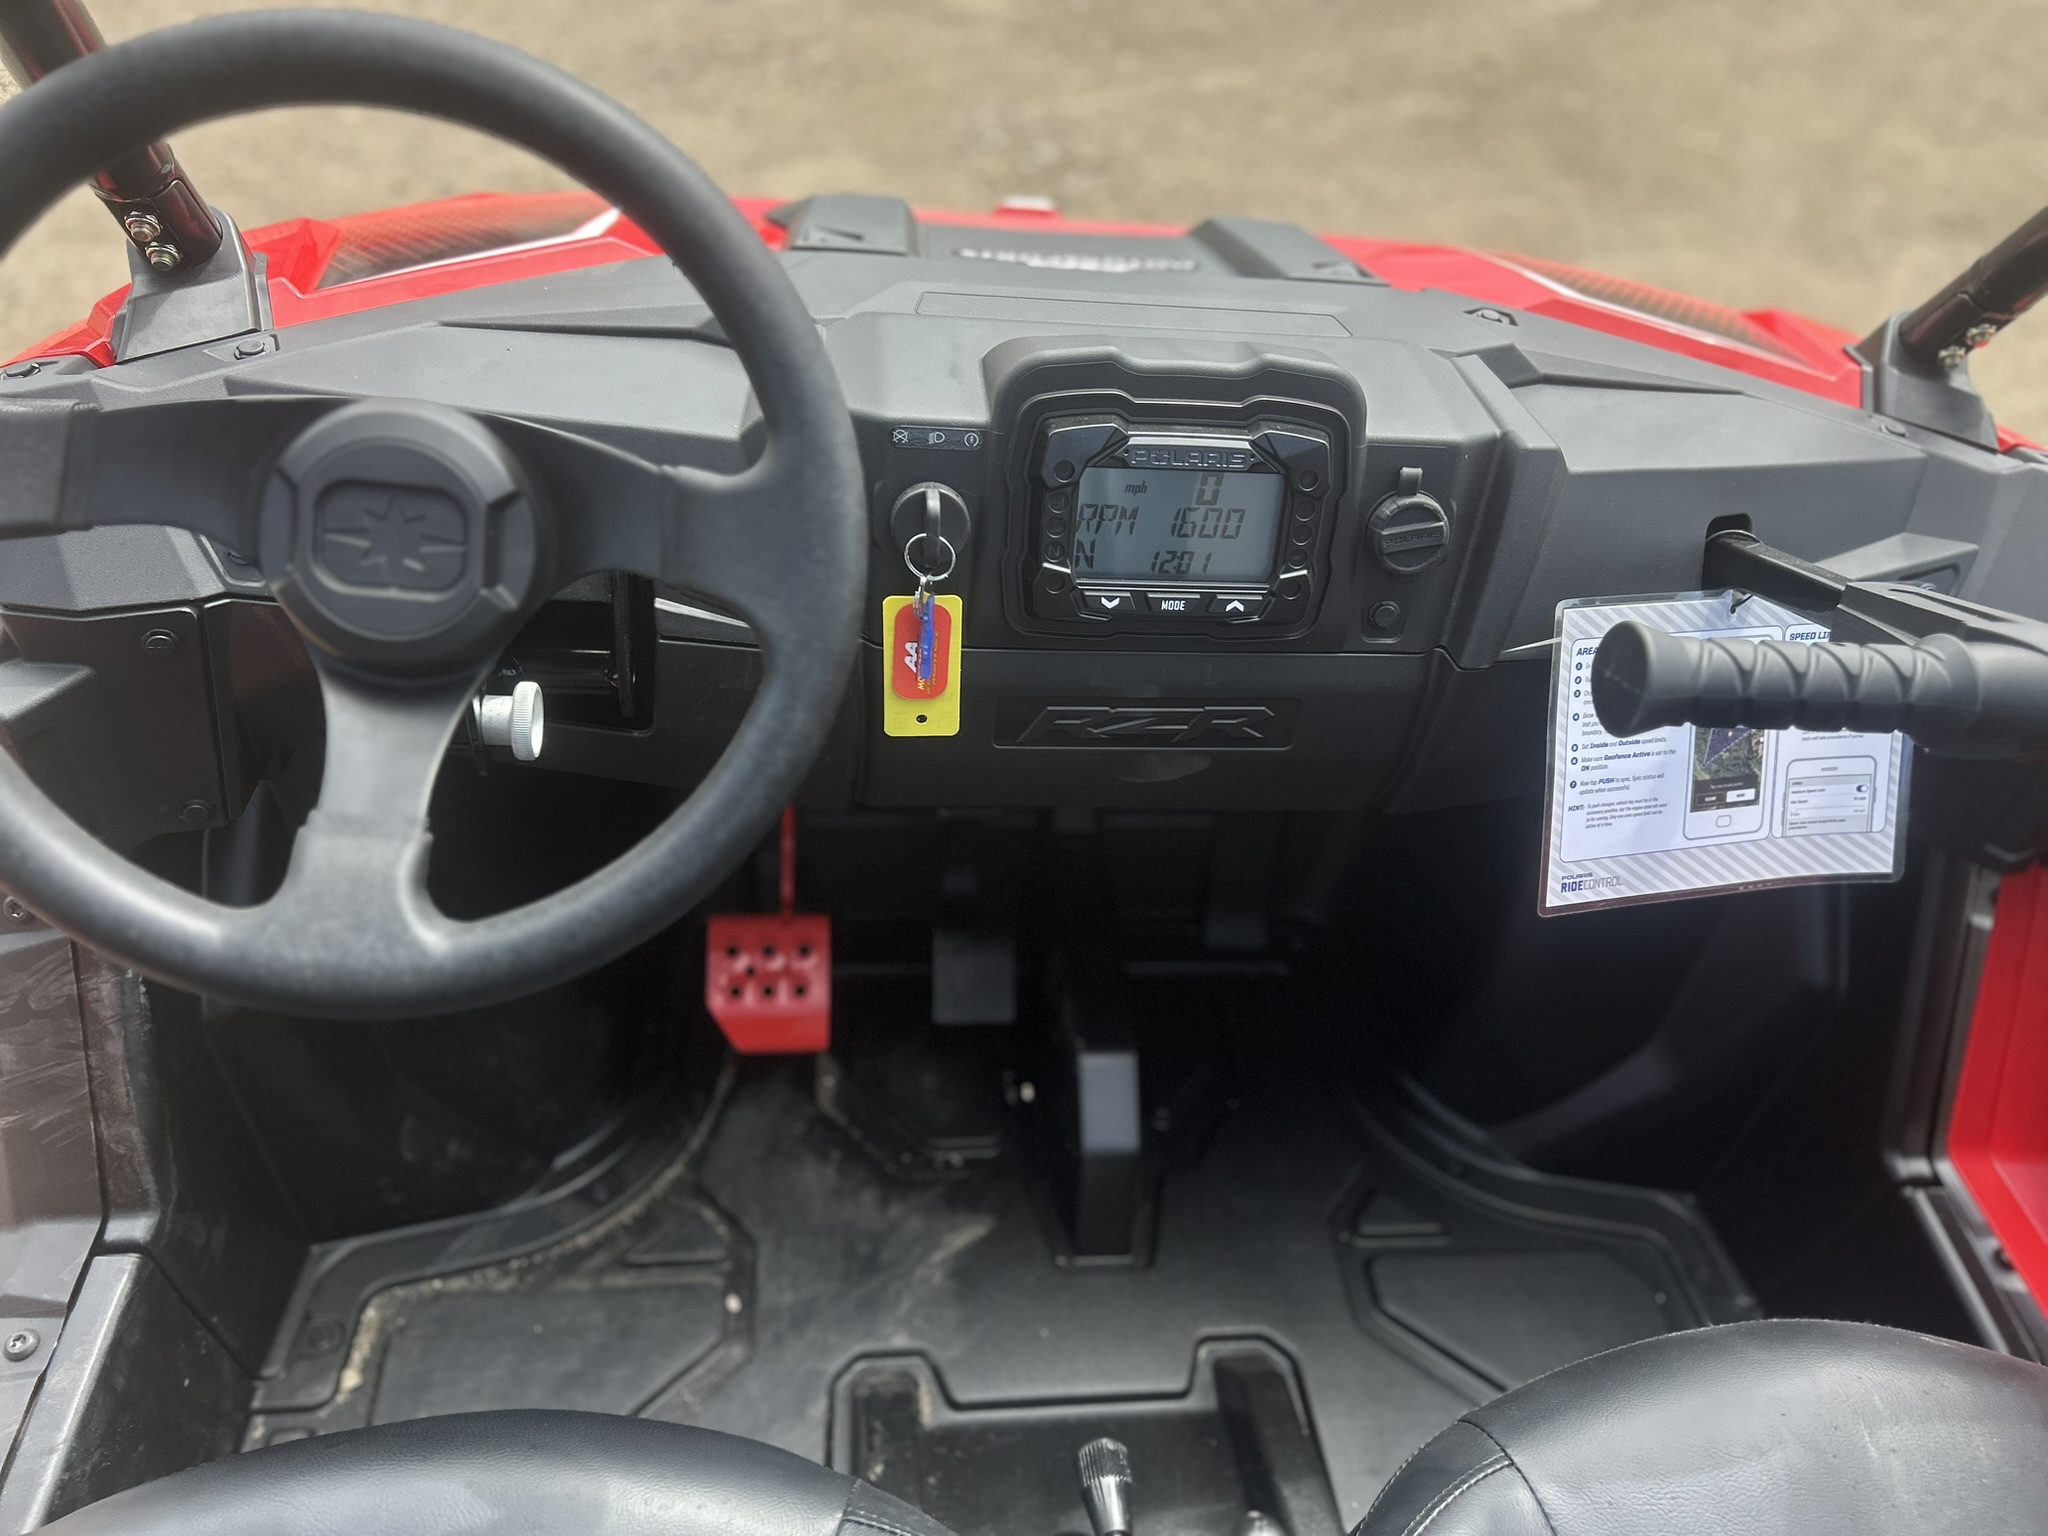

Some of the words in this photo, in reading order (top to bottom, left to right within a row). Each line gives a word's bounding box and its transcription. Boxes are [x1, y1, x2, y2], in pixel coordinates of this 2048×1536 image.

[1131, 449, 1247, 468] POLARIS
[1125, 481, 1147, 496] mph
[1196, 471, 1224, 505] 0
[1076, 504, 1140, 535] RPM
[1171, 507, 1246, 540] 1600
[1384, 530, 1443, 547] POLARIS
[1075, 539, 1096, 570] N
[1151, 550, 1213, 575] 12:01
[1161, 600, 1186, 611] MODE
[1789, 632, 1817, 641] SPEED
[1016, 706, 1276, 744] RZR
[1561, 871, 1594, 881] POLARIS
